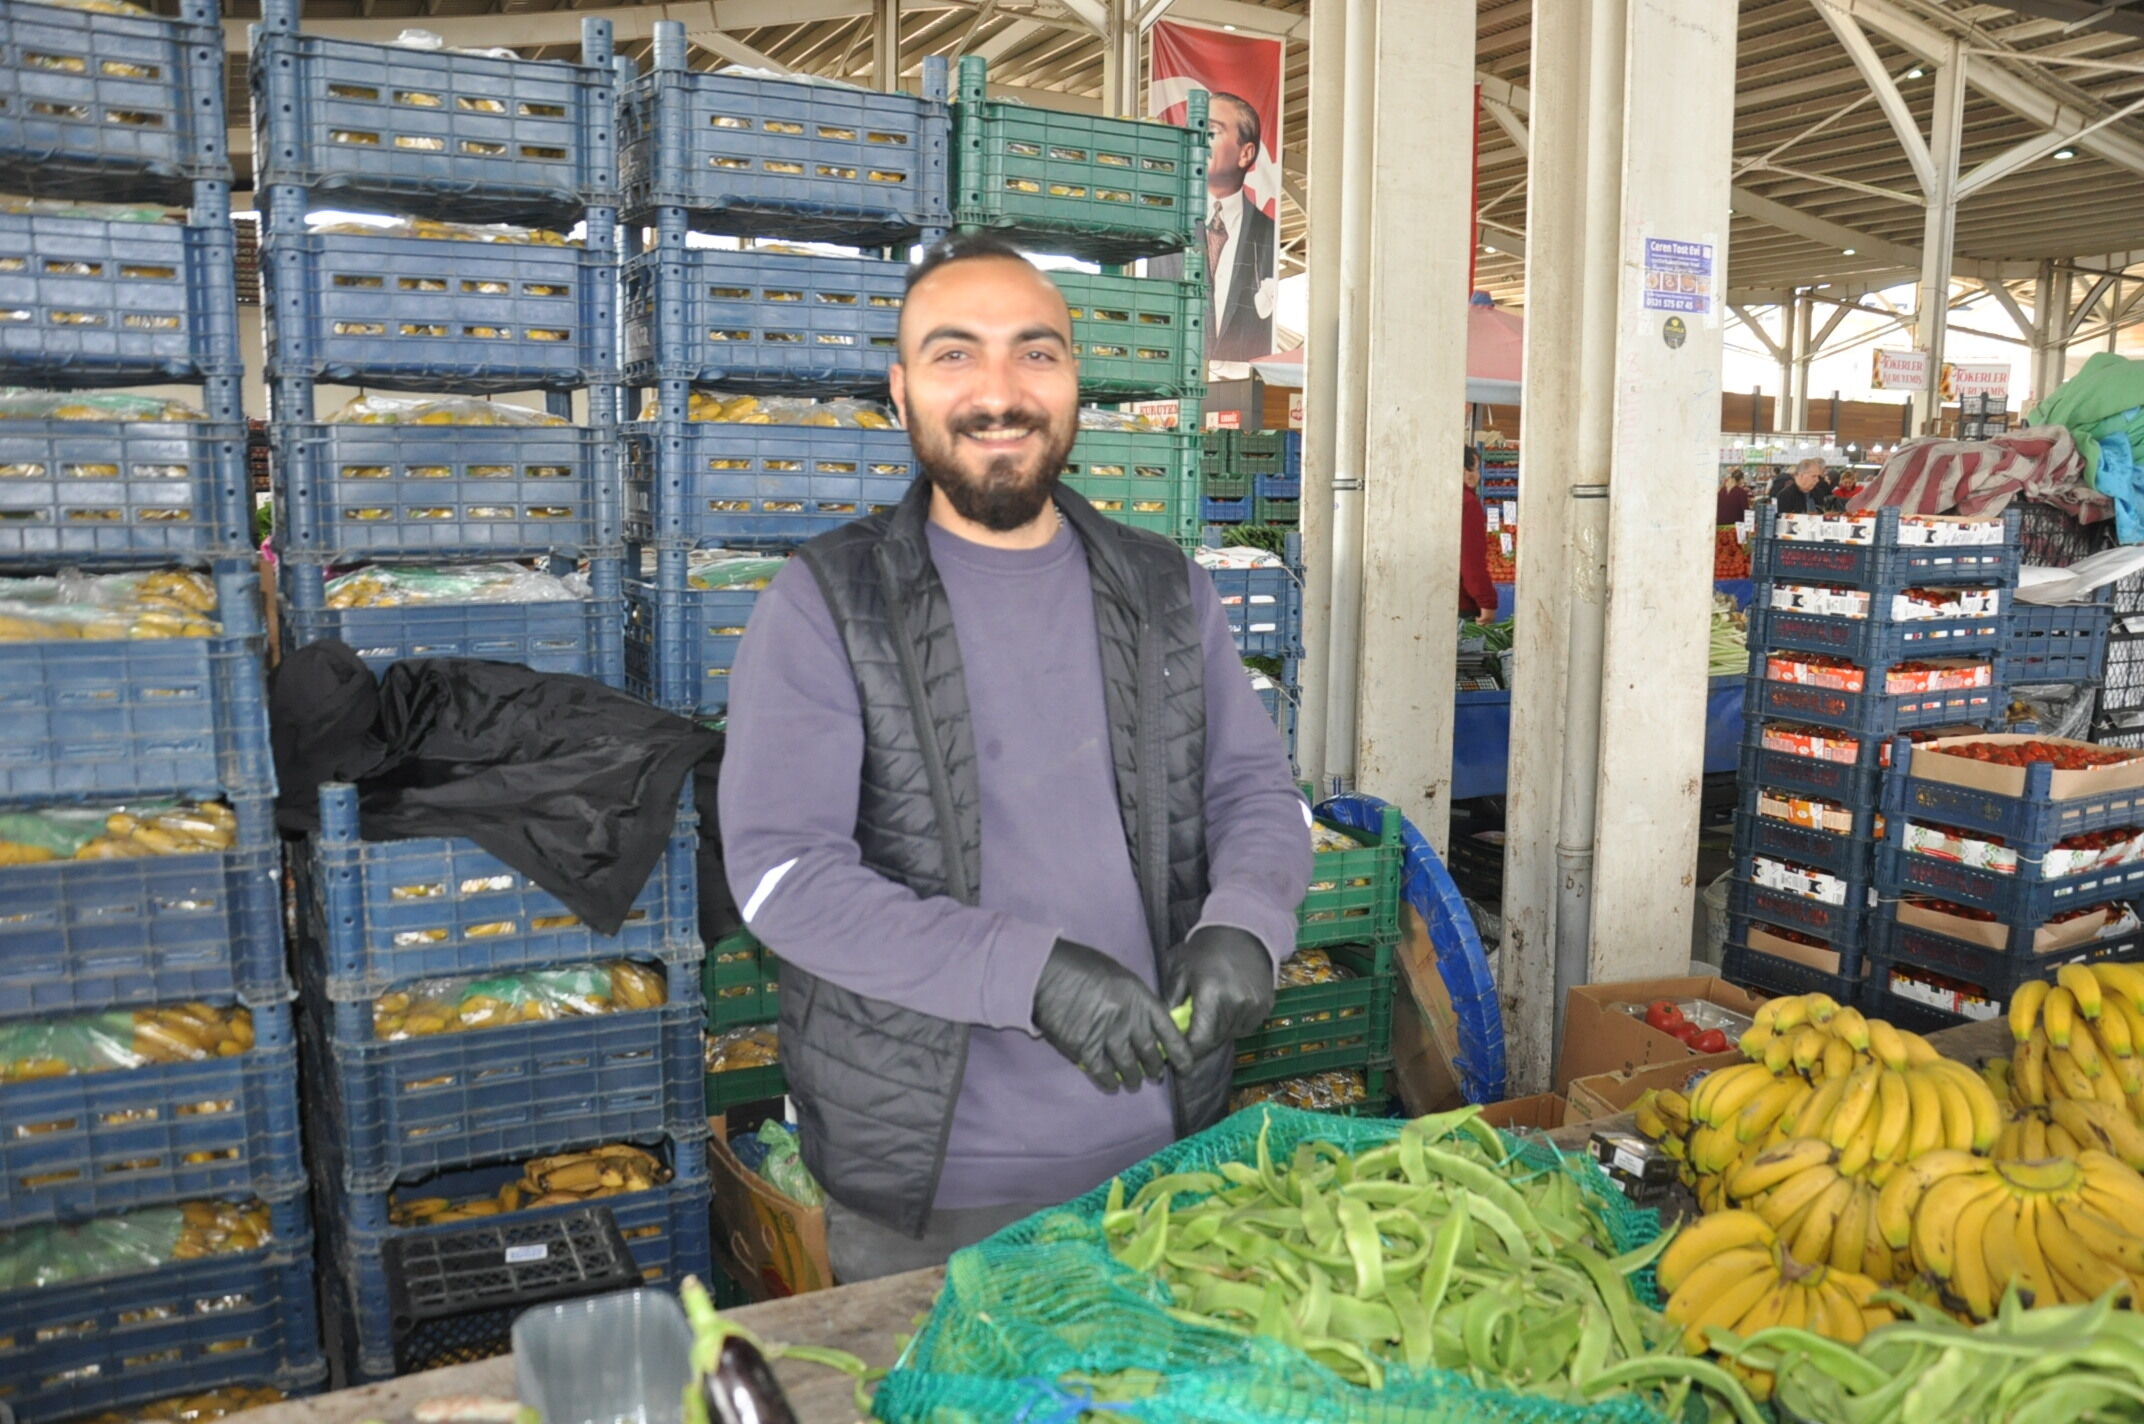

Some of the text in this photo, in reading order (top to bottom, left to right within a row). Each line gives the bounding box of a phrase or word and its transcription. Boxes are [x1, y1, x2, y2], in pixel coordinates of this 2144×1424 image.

[1651, 241, 1672, 252] Ceren
[1672, 243, 1689, 254] Tost
[1954, 368, 2008, 383] TOKERLER
